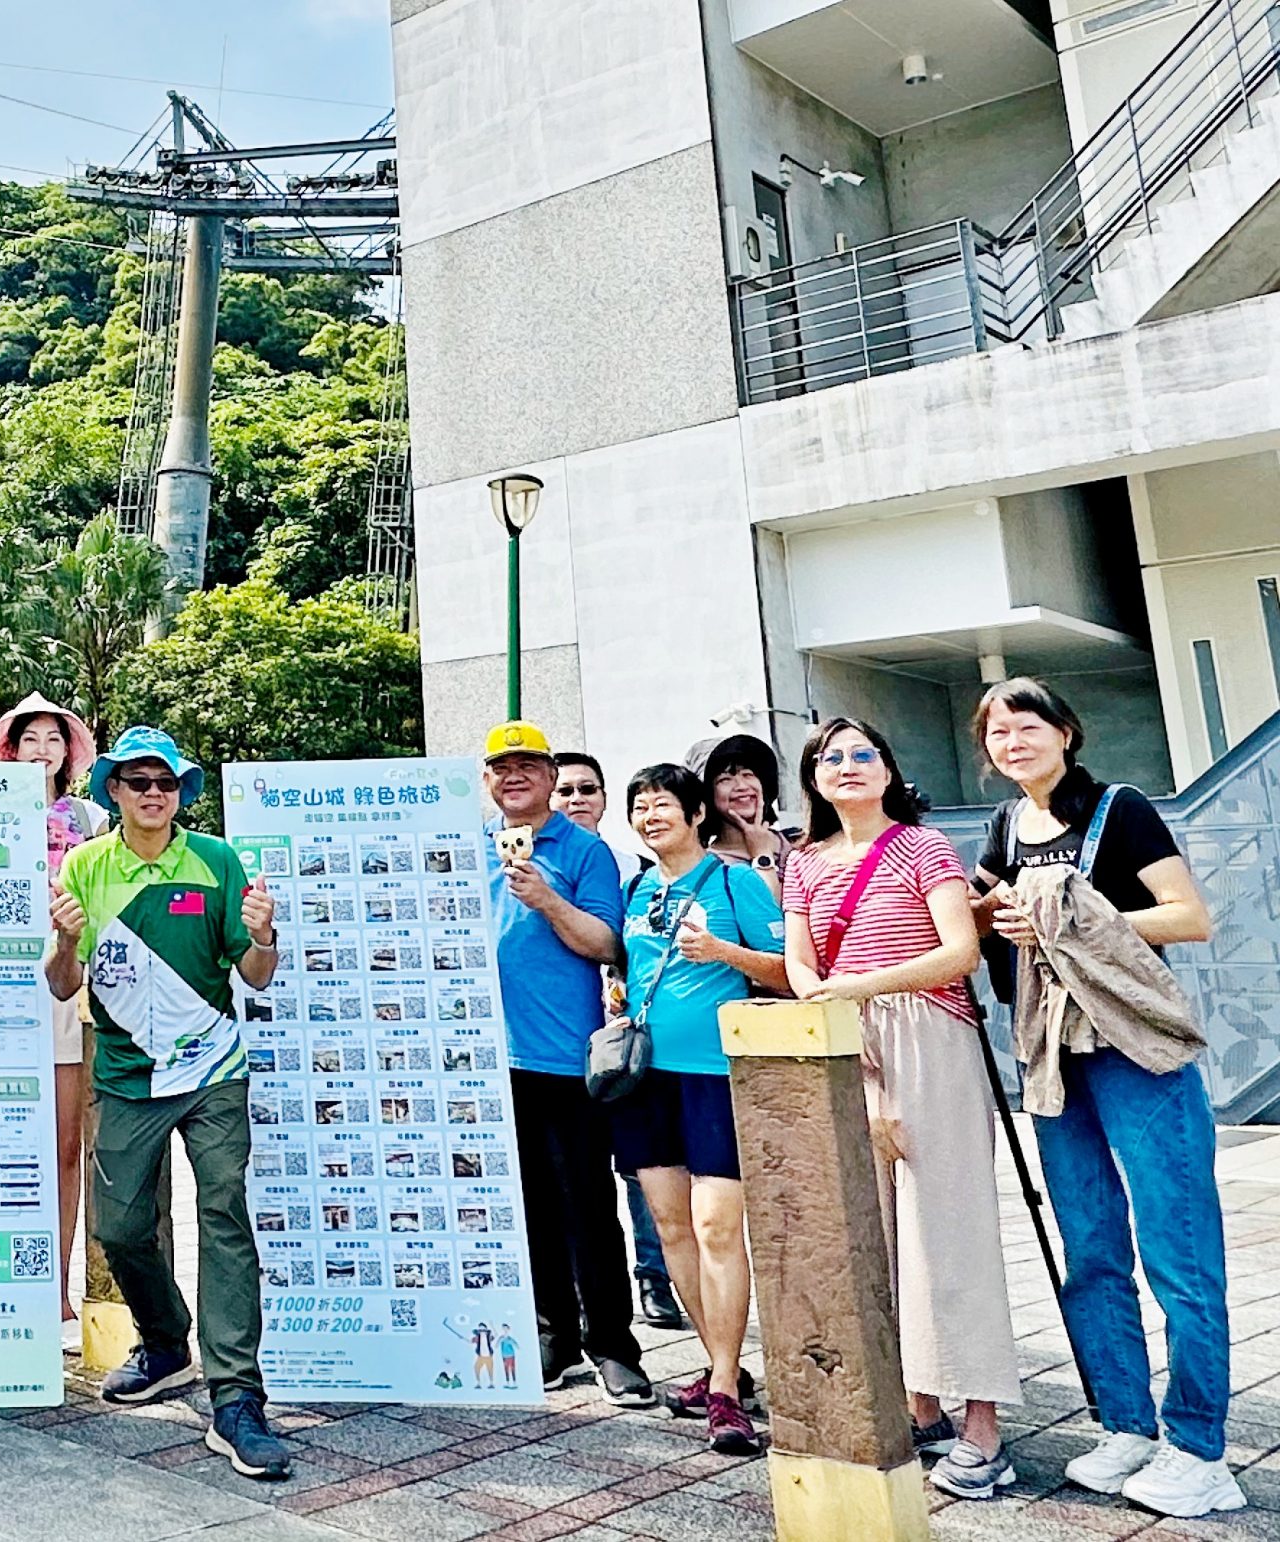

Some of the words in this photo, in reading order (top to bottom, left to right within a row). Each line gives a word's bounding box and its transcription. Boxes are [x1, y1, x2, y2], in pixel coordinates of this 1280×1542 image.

[261, 786, 346, 809] 貓空山城
[353, 784, 441, 807] 綠色旅遊
